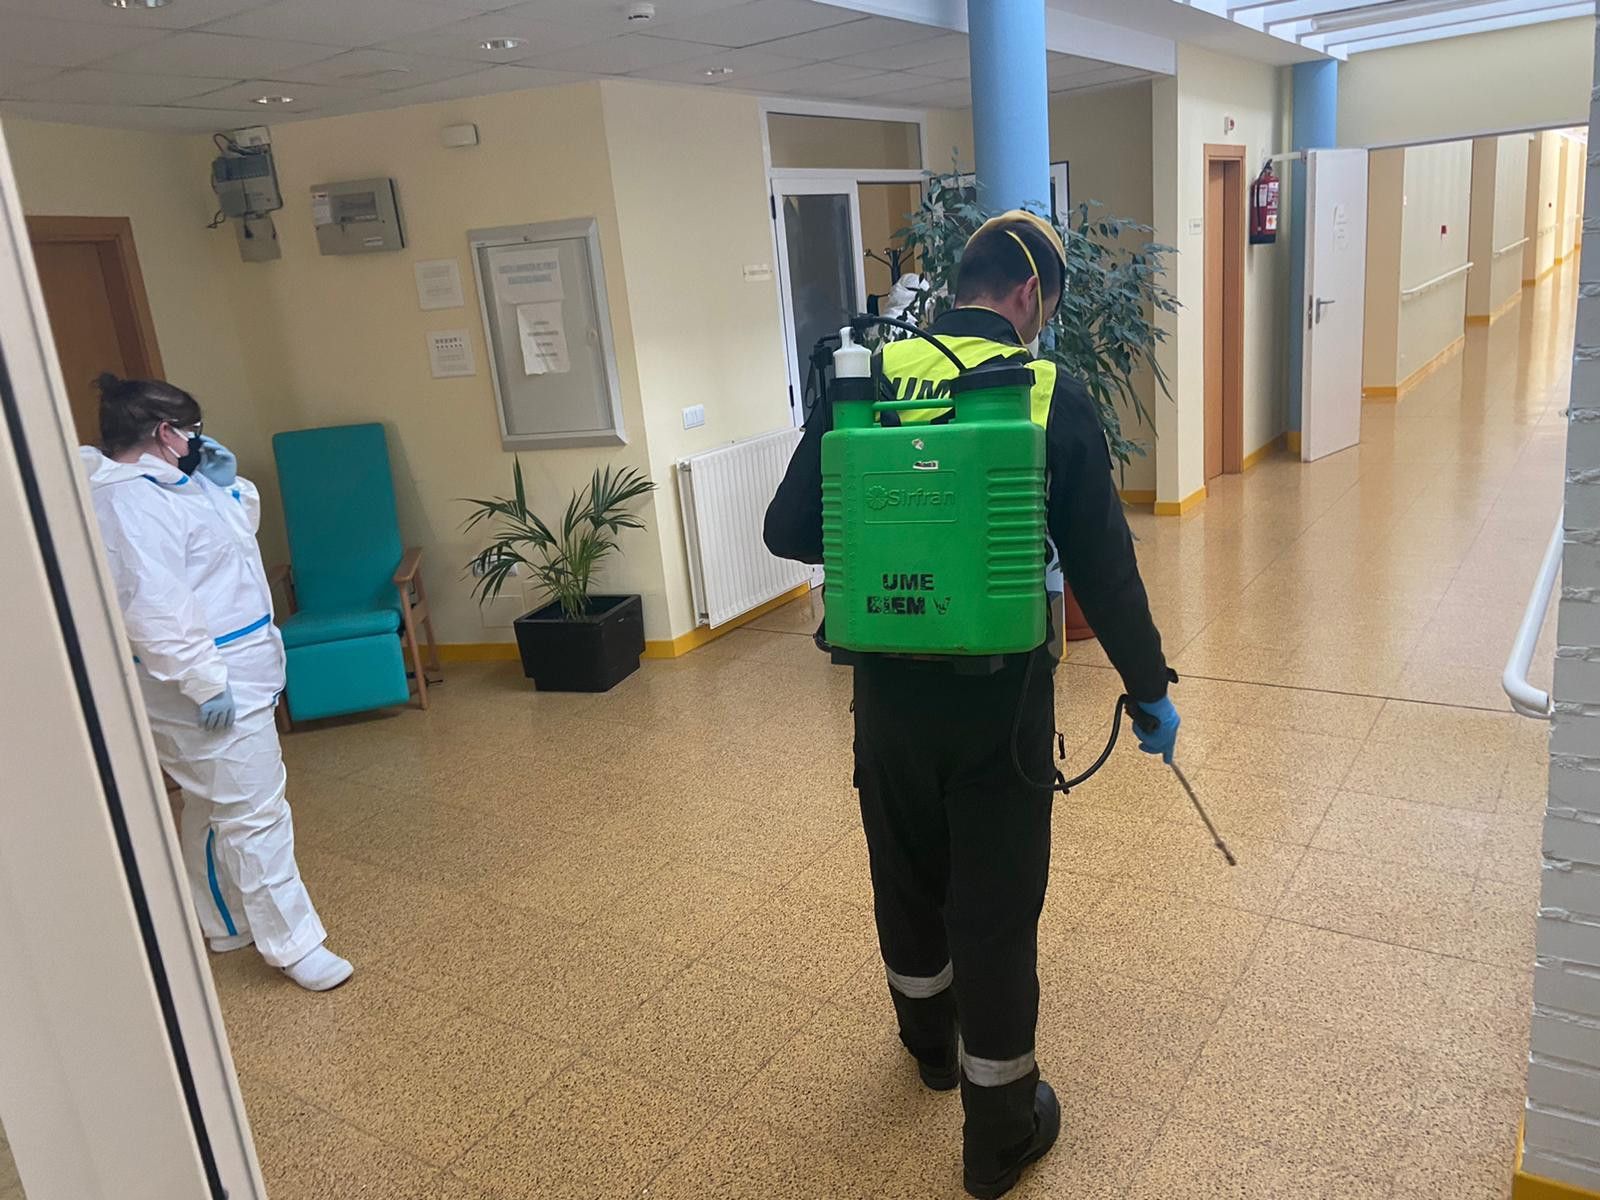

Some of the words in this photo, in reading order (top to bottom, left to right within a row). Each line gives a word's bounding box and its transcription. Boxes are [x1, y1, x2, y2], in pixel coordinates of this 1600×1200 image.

[891, 377, 953, 400] UM
[888, 488, 955, 506] Sirfran
[882, 573, 935, 591] UME
